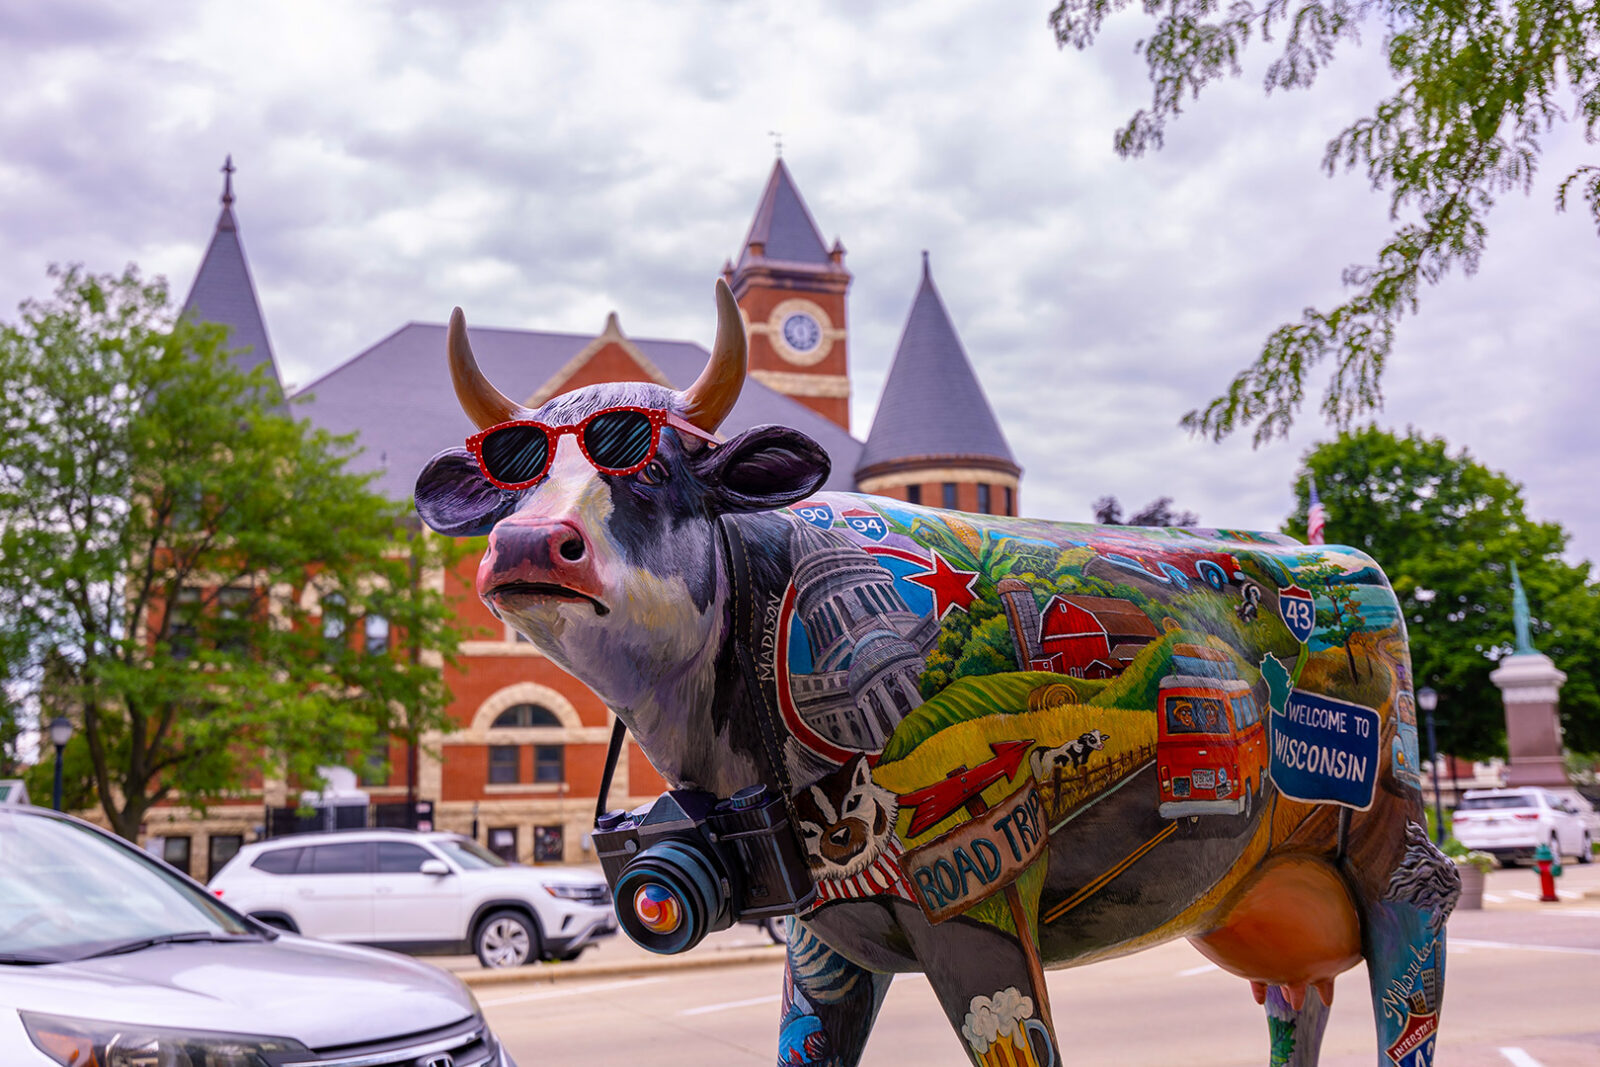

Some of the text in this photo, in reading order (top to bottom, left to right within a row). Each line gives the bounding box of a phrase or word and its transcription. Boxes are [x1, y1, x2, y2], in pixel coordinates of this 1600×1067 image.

[800, 508, 829, 522] 90
[852, 519, 882, 534] 94
[1285, 600, 1312, 631] 43
[759, 589, 781, 682] MADISON
[1288, 701, 1370, 739] WELCOME TO
[1275, 728, 1367, 783] WISCONSIN
[913, 788, 1042, 911] ROAD TRIP
[1393, 1019, 1435, 1060] INTERSTATE
